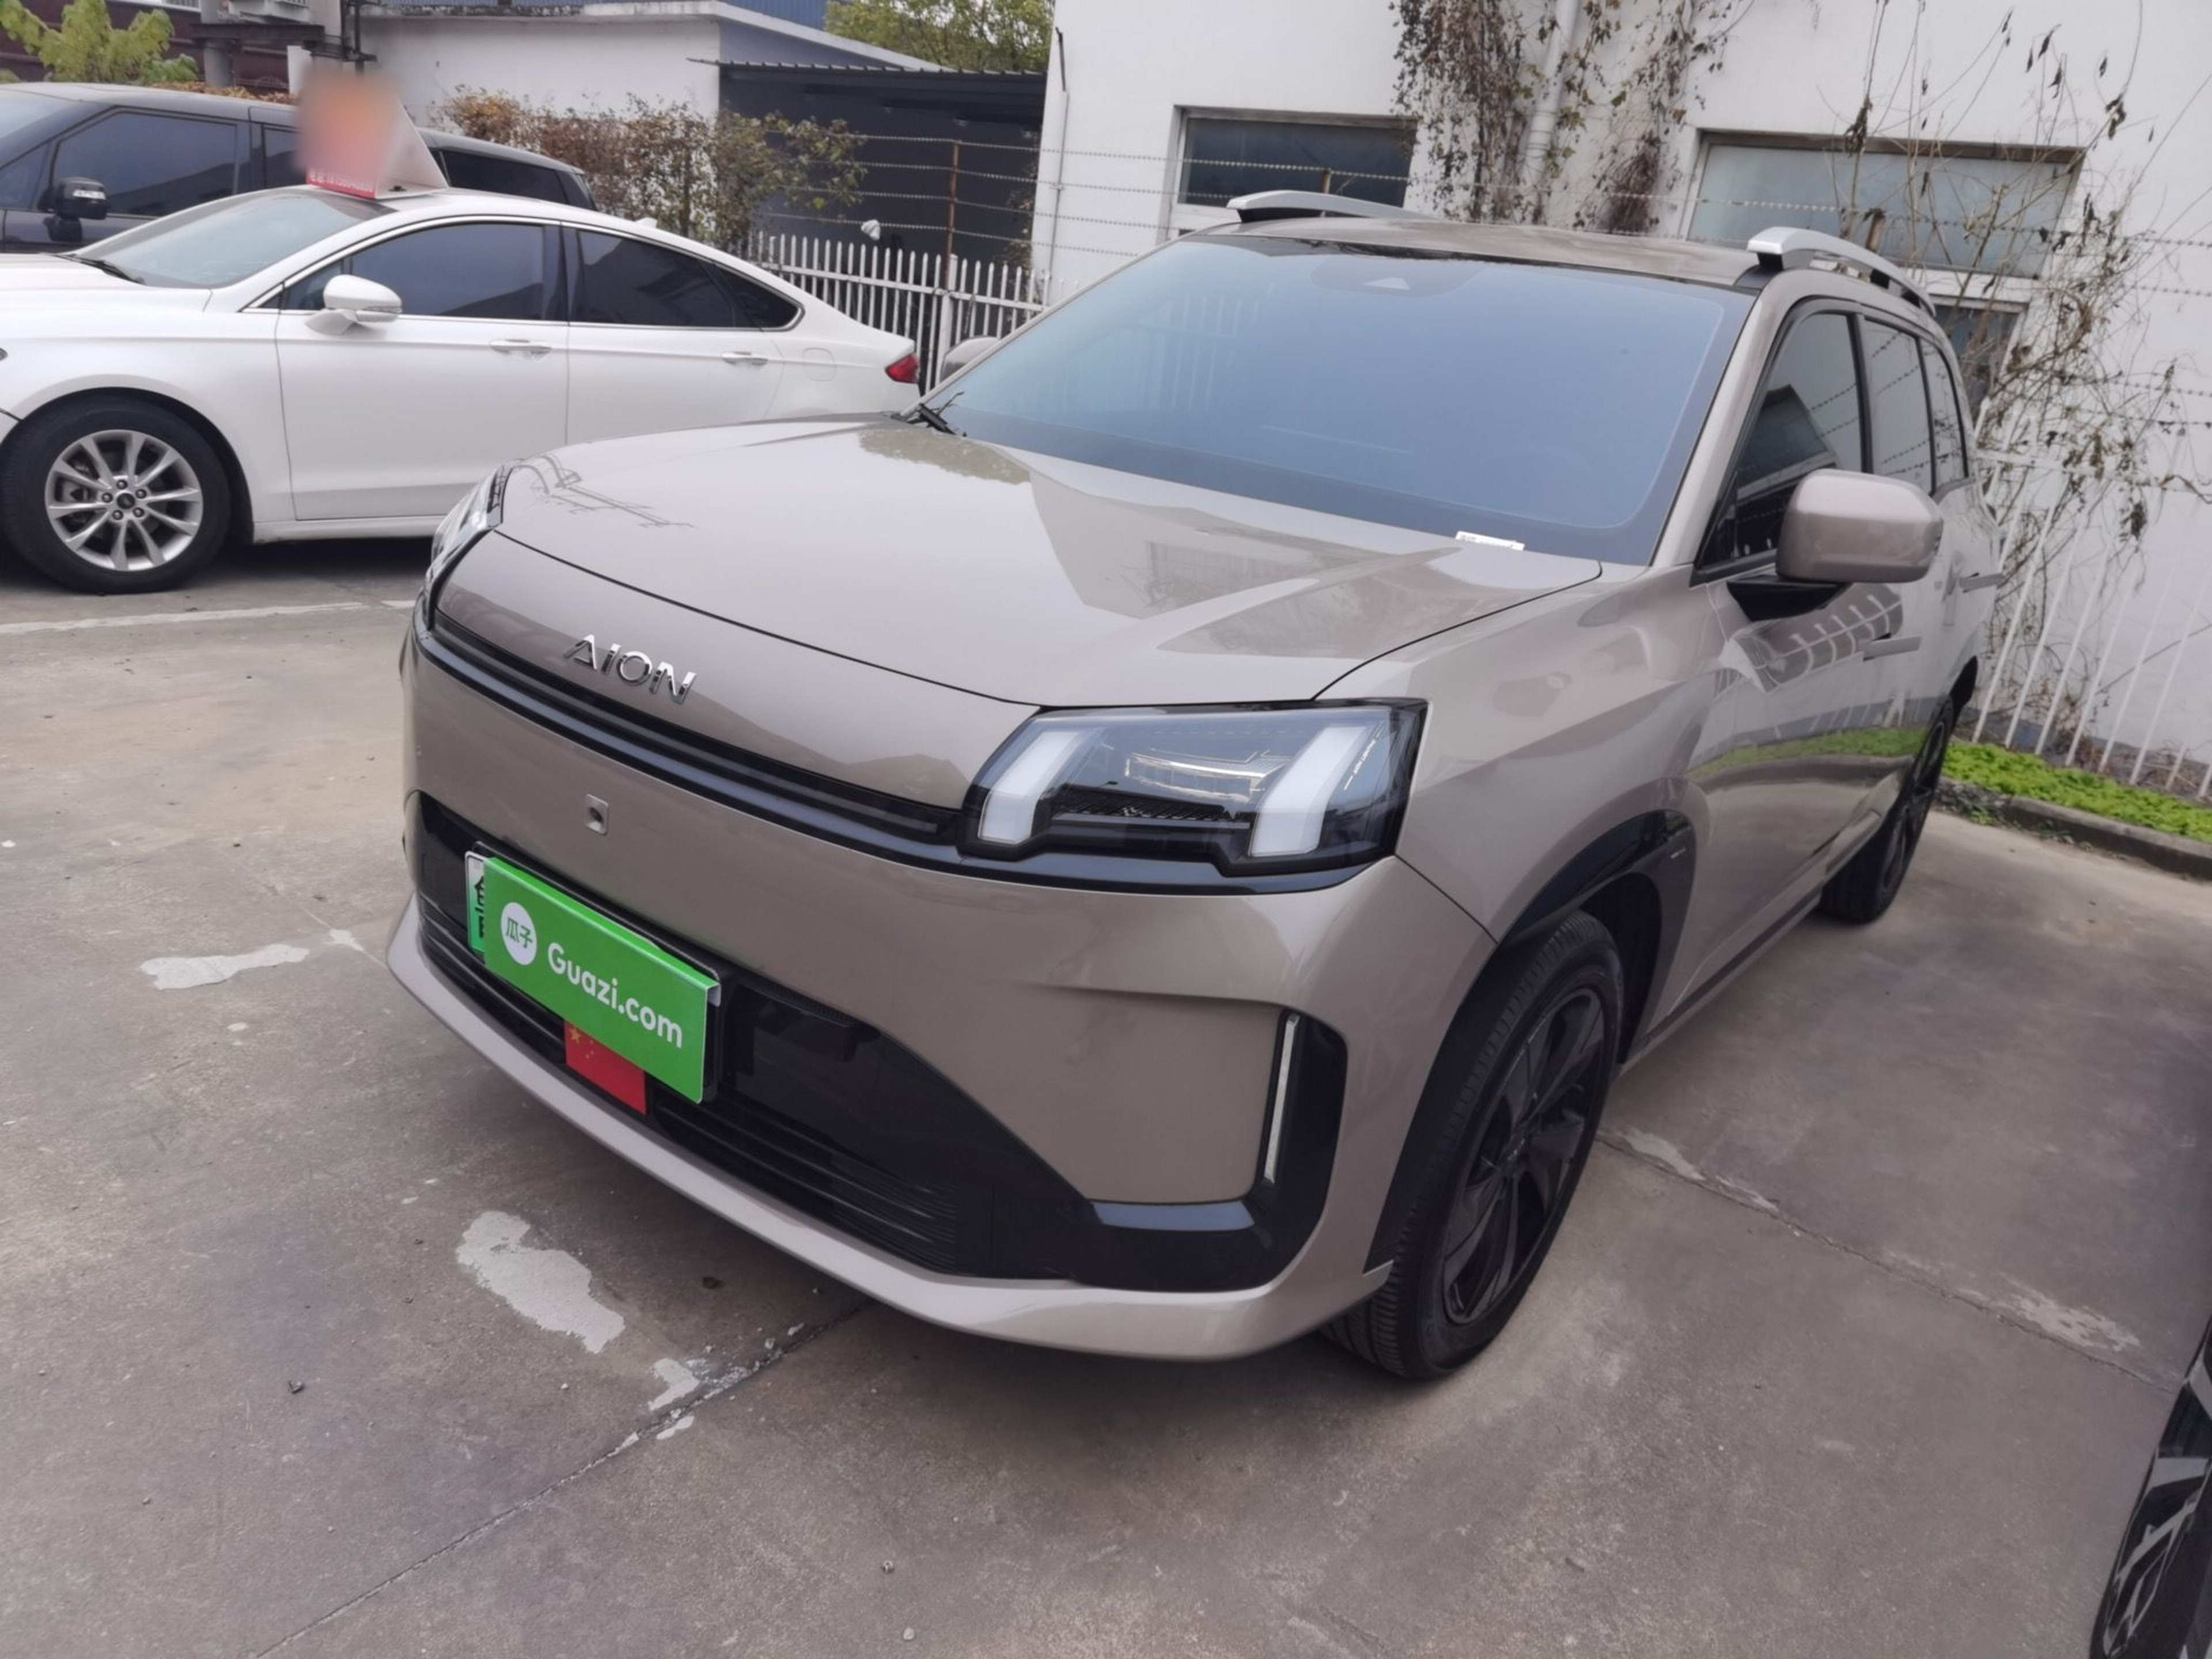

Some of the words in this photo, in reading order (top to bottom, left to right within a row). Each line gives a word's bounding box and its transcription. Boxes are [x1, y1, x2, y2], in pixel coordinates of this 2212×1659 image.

[564, 634, 696, 704] AION
[506, 916, 533, 949] 瓜子
[547, 942, 683, 1048] Guazi.com
